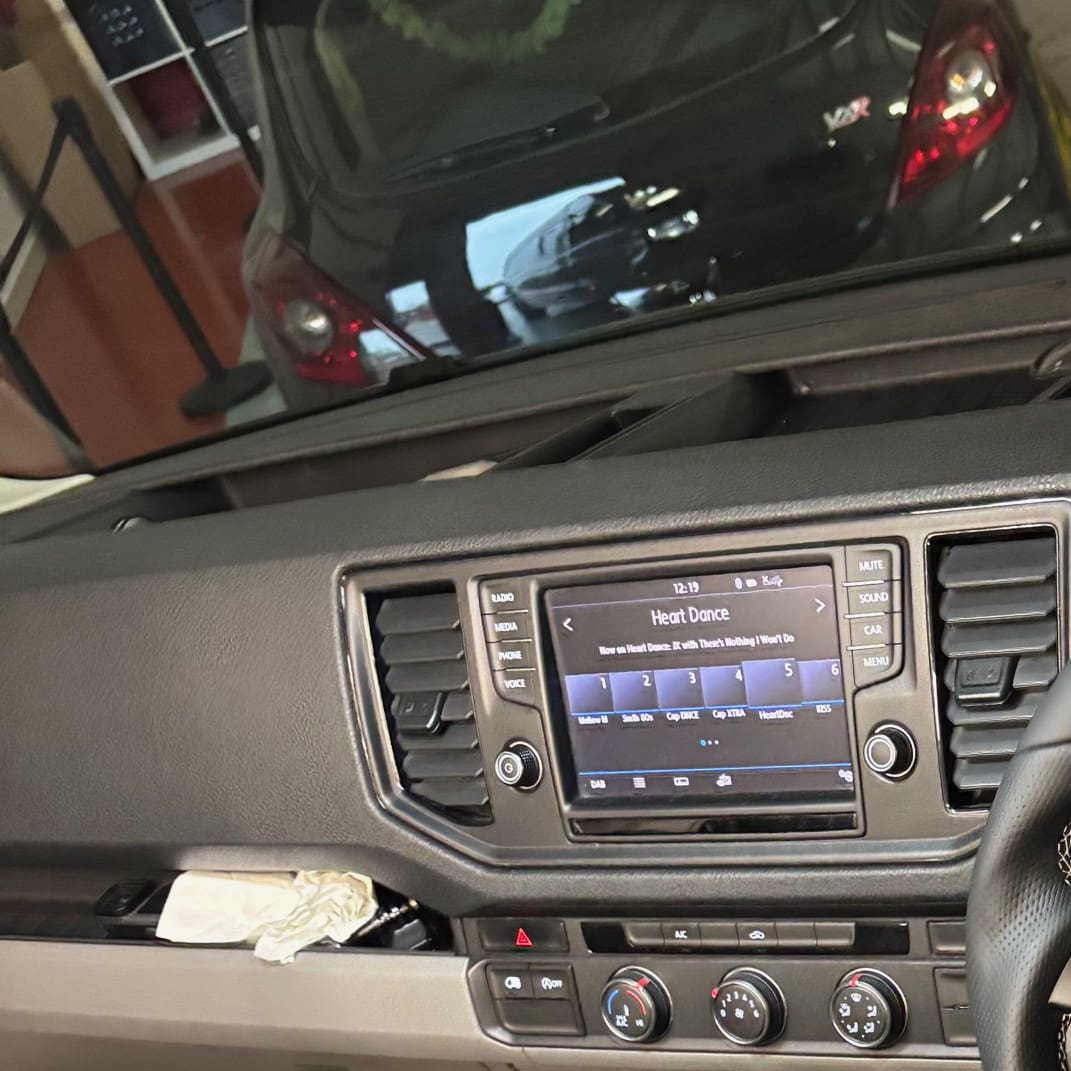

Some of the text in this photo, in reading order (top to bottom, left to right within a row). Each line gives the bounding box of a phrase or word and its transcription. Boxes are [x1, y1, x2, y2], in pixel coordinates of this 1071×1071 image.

[859, 560, 884, 571] MUTE
[673, 582, 699, 594] 12:19
[491, 592, 514, 602] RADIO
[859, 592, 889, 604] SOUND
[651, 606, 730, 626] Heart Dance
[495, 621, 518, 632] MEDIA
[864, 625, 883, 635] CAR
[498, 651, 522, 661] PHONE
[864, 656, 889, 667] MENU
[735, 669, 743, 681] 4
[784, 663, 793, 677] 5
[831, 664, 839, 675] 6
[601, 677, 607, 689] 1
[643, 675, 651, 686] 2
[689, 672, 697, 684] 3
[504, 679, 525, 689] VOICE
[590, 779, 606, 789] DAB
[727, 994, 732, 1002] 2
[735, 992, 739, 1000] 3
[722, 1000, 727, 1008] 1
[750, 1000, 755, 1008] 5
[720, 1009, 726, 1018] 0
[753, 1009, 759, 1018] 6
